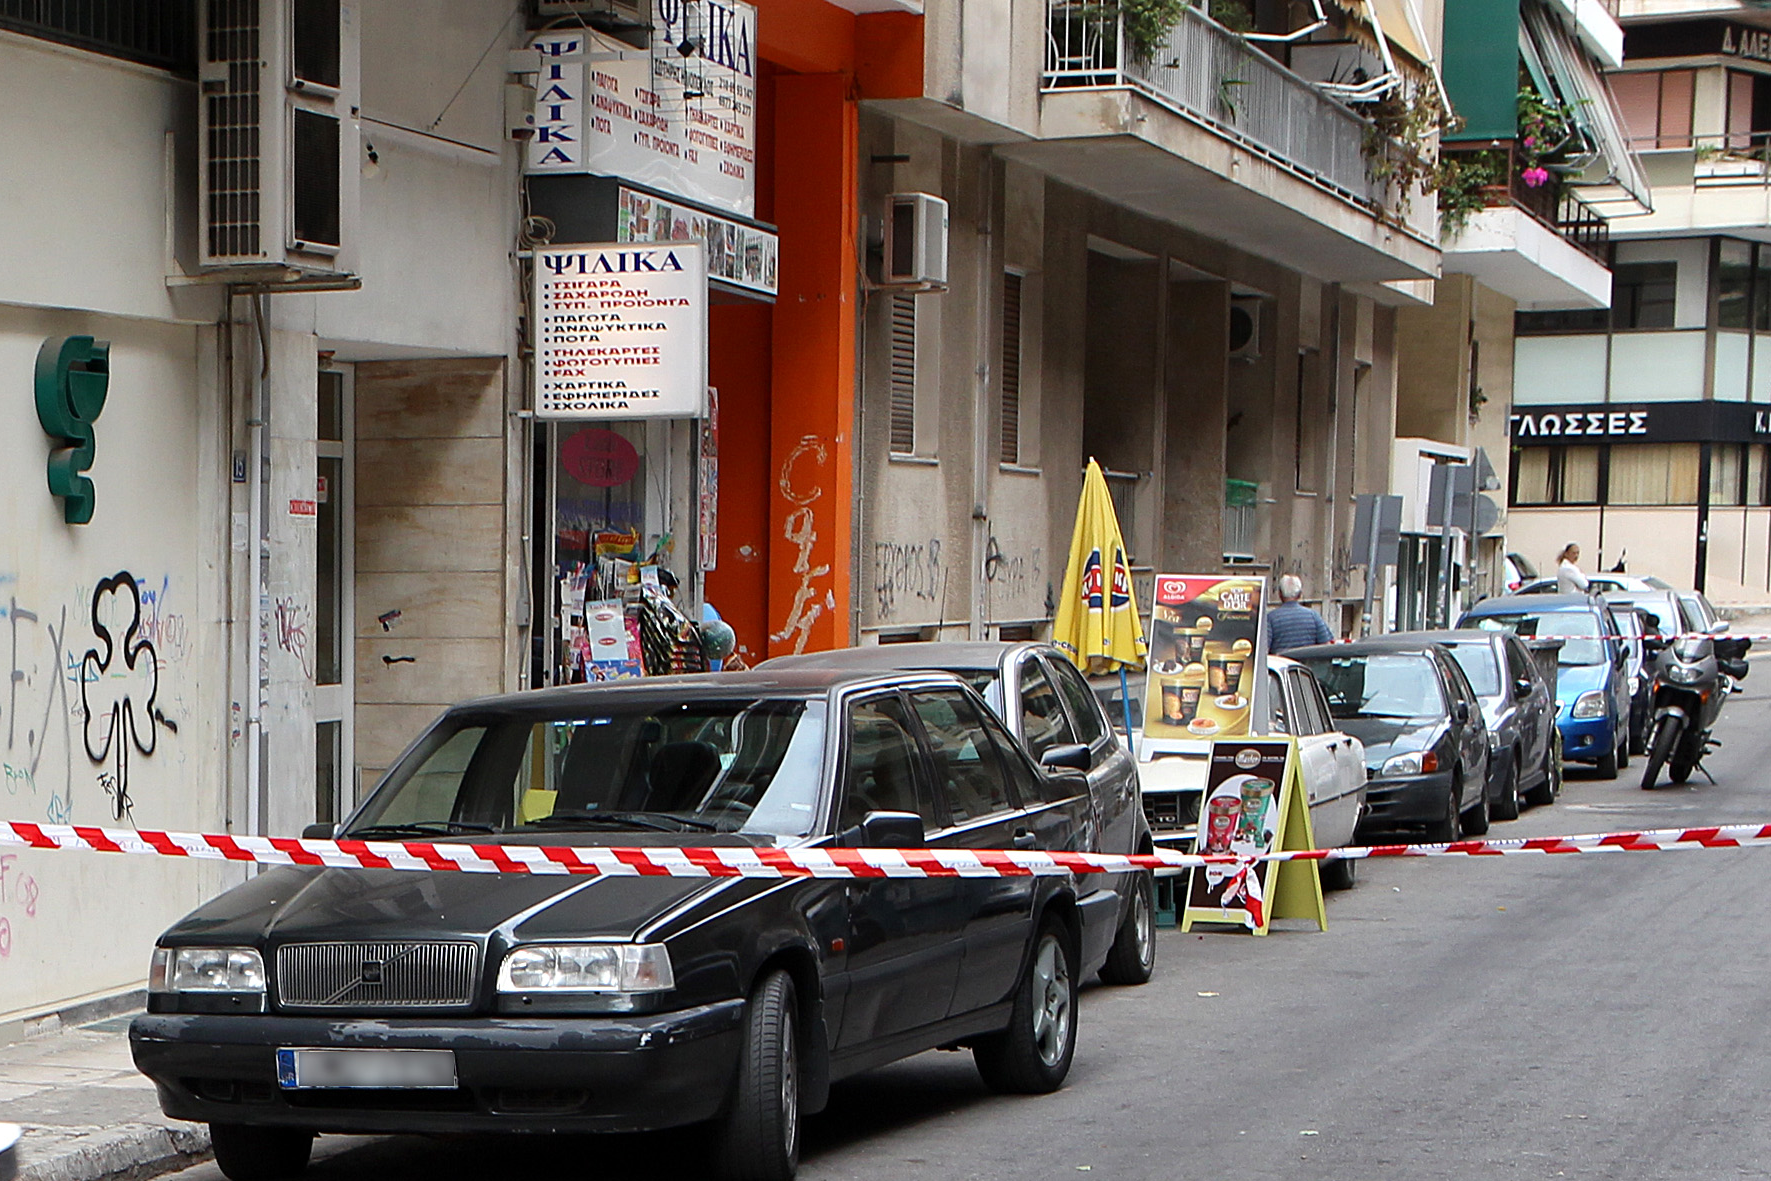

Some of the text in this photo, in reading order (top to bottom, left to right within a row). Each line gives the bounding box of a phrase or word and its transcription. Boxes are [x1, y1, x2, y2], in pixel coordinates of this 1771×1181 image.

[658, 0, 752, 78] ΨΙΙΚΑ
[532, 41, 580, 165] ΨΙΛΙΚΑ
[543, 250, 684, 275] ΨΙΛΙΚΑ
[553, 280, 622, 290] ΤΣΙΓΑΡΑ
[553, 290, 648, 300] ΣΑΧΑΡΩΔΗ
[553, 301, 591, 310] ΤΥΠ.
[553, 313, 622, 323] ΠΑΓΩΤΑ
[553, 322, 668, 333] ΑΝΑΨΥΚΤΙΚΑ
[553, 335, 601, 344] ΠΟΤΑ
[553, 347, 661, 357] ΤΗΛΕΚΑΡΤΕΣ
[553, 357, 661, 368] ΦΩΤΟΤΥΠΙΕΣ
[553, 369, 587, 377] FAX
[553, 381, 627, 390] ΧΑΡΤΙΚΑ
[553, 390, 660, 401] ΕΦΗΜΕΡΙΔΕΣ
[553, 401, 630, 410] ΣΧΟΛΙΚΑ
